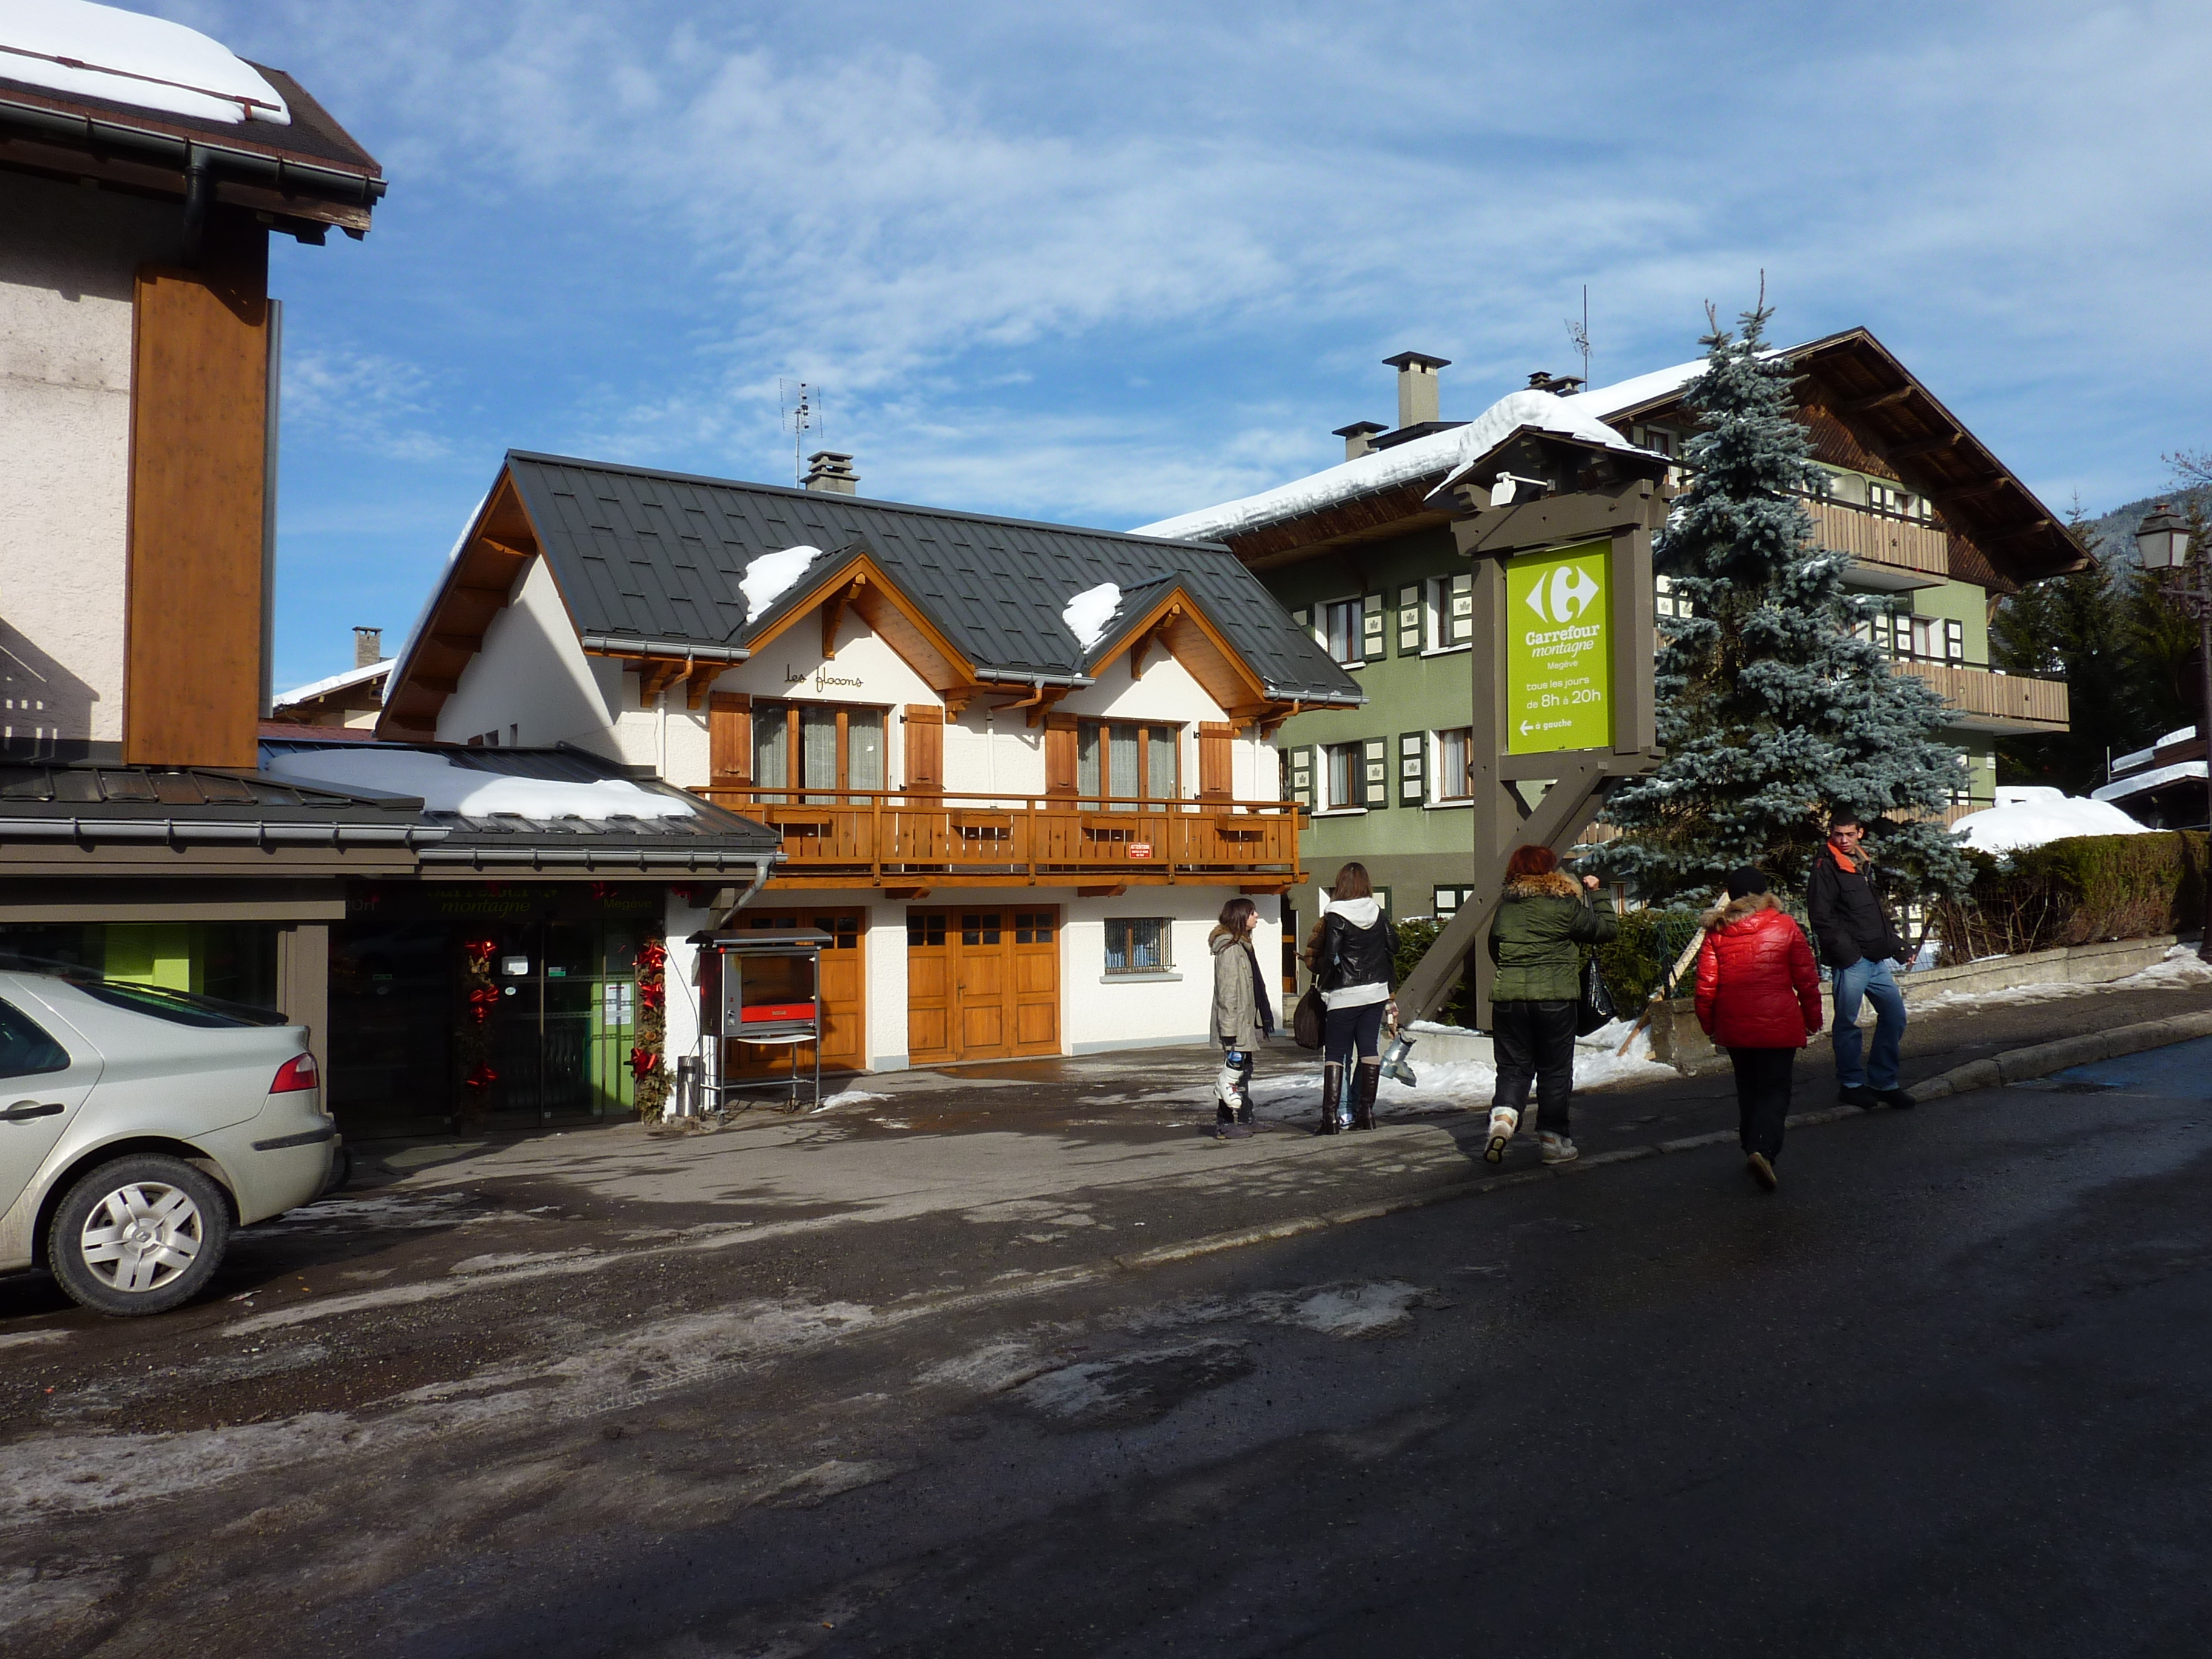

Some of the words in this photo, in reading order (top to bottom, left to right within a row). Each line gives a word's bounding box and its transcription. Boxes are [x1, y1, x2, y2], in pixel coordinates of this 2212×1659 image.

[1526, 625, 1600, 646] Carrefour
[1532, 640, 1594, 658] montagne
[1547, 660, 1578, 670] Megève
[1564, 677, 1589, 689] jours
[1527, 700, 1538, 709] de
[1541, 694, 1560, 708] 8h
[1563, 695, 1569, 705] à
[1572, 689, 1601, 703] 20h
[1543, 719, 1572, 731] gauche
[441, 899, 531, 918] montagne
